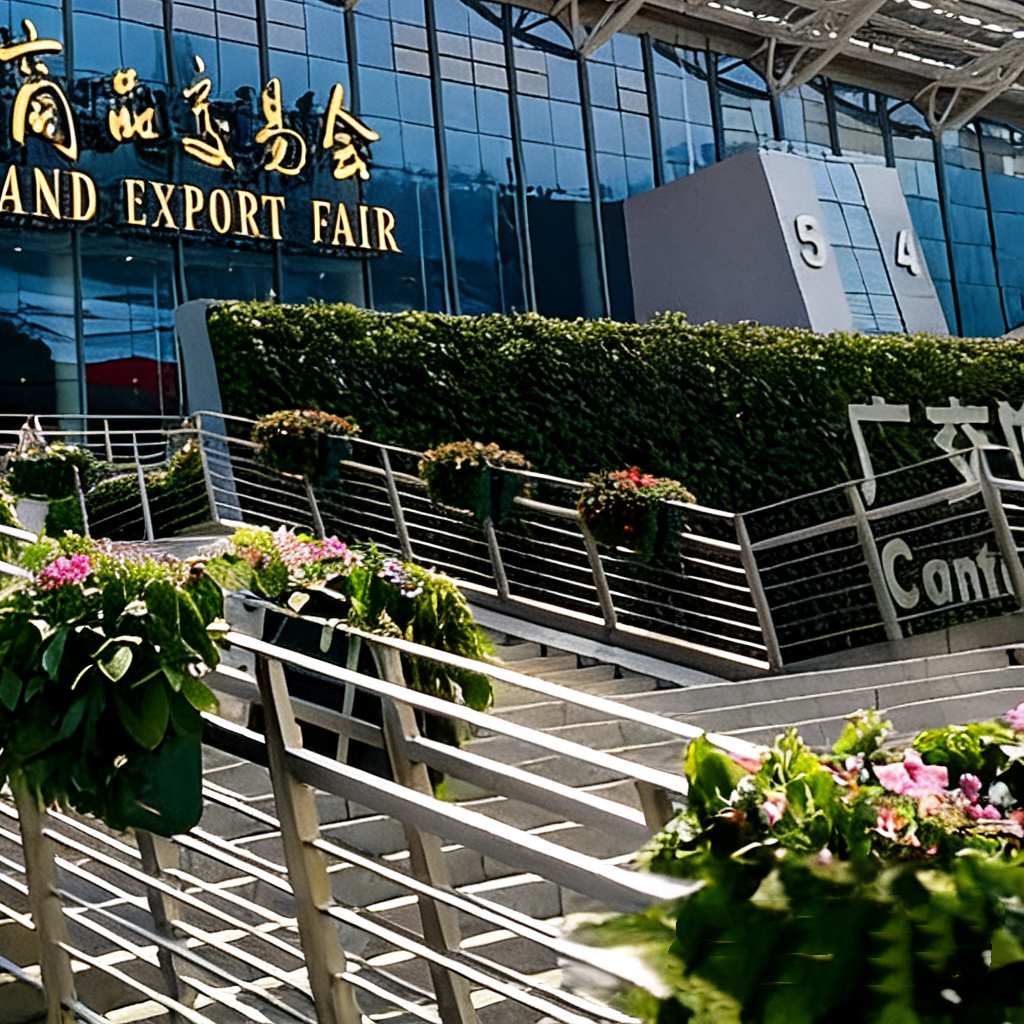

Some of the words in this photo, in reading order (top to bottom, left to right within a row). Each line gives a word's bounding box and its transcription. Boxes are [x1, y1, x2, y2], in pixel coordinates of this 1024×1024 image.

[123, 179, 285, 240] EXPORT
[311, 200, 403, 253] FAIR
[895, 229, 921, 276] 4
